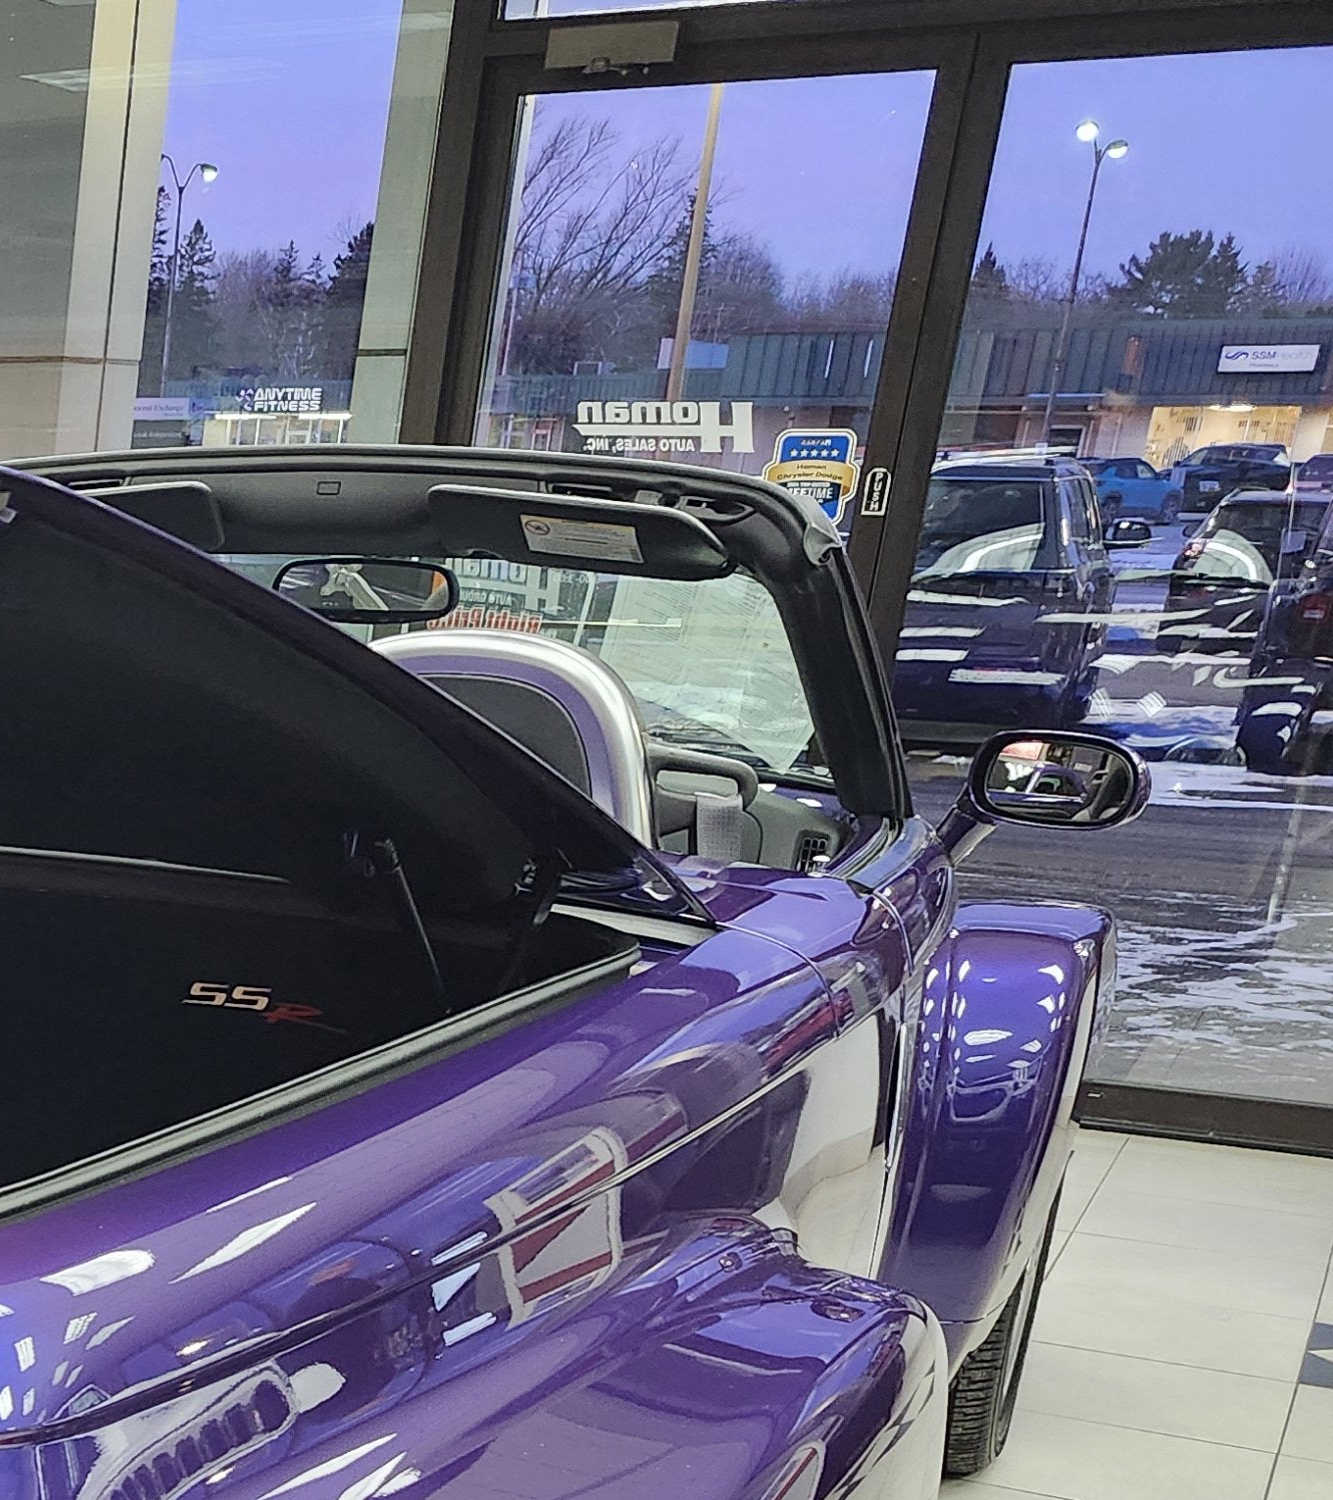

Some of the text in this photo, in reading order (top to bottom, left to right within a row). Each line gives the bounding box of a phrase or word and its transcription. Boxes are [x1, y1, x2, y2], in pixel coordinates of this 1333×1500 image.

[253, 387, 323, 401] ANYTIME
[254, 401, 321, 412] FITNESS
[869, 472, 883, 512] PUSH
[181, 980, 346, 1035] SSR
